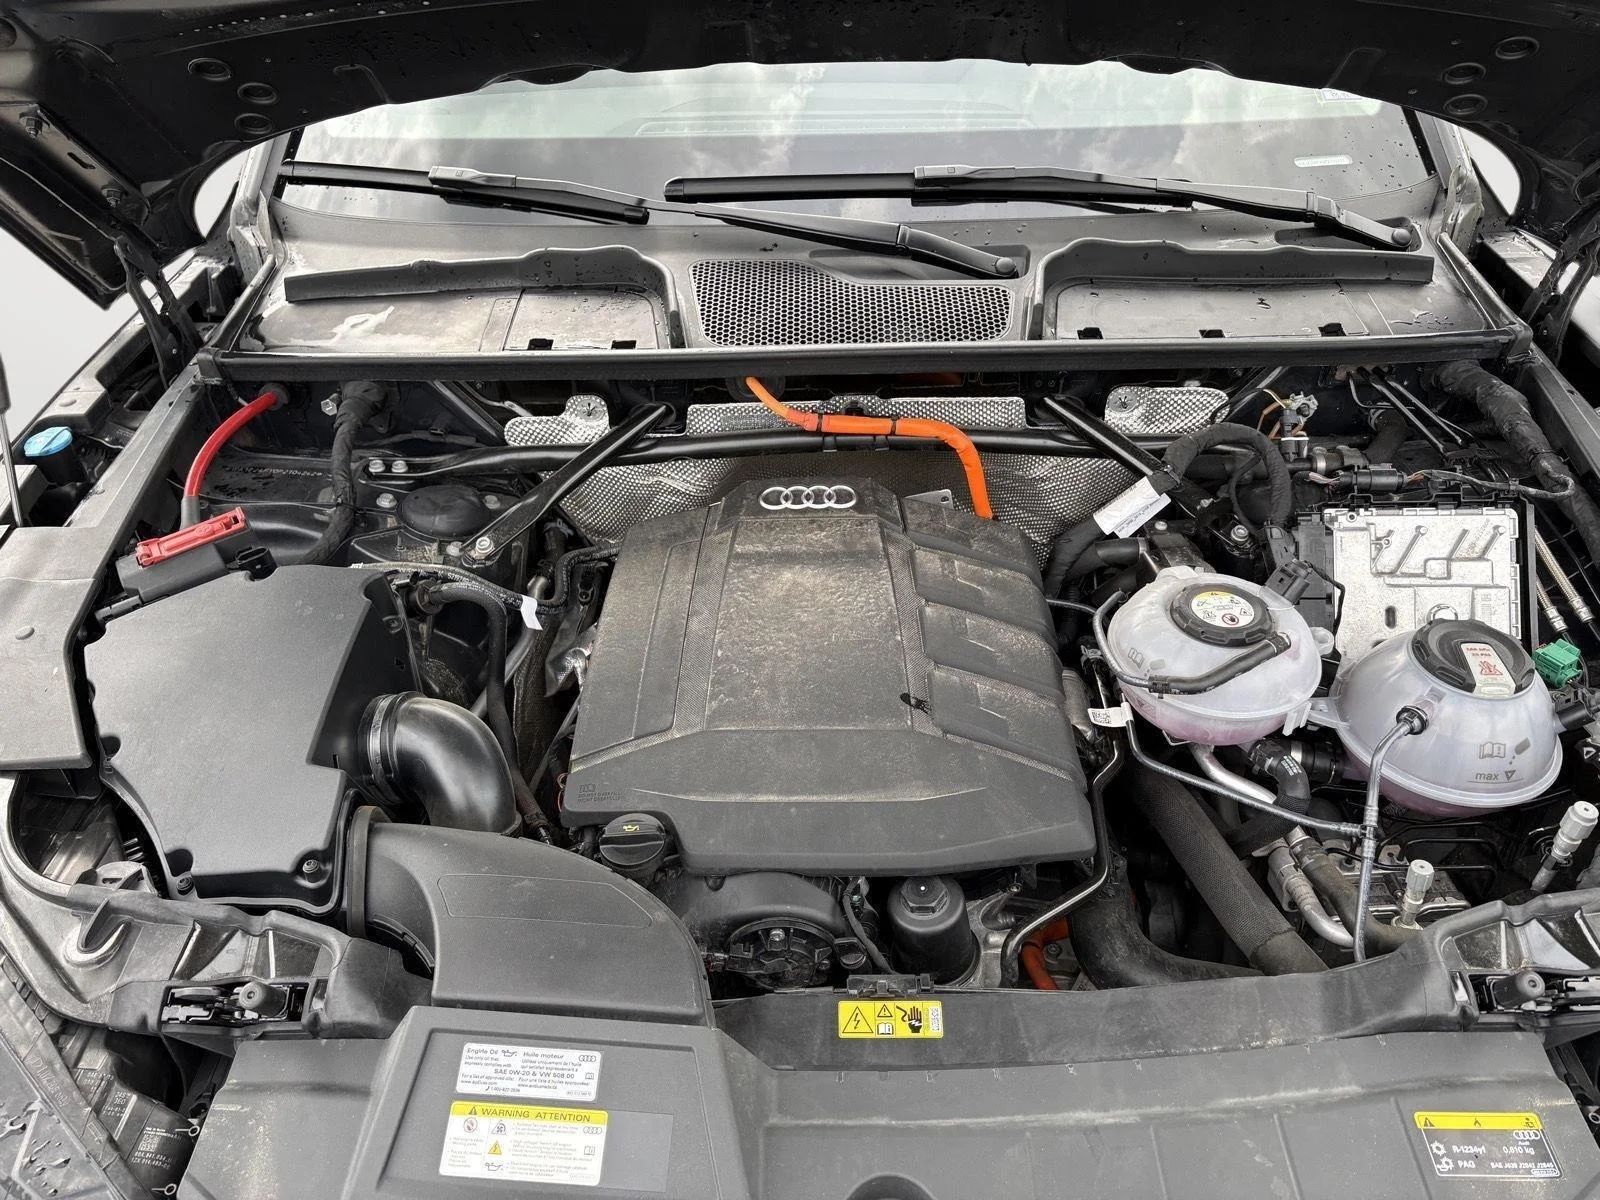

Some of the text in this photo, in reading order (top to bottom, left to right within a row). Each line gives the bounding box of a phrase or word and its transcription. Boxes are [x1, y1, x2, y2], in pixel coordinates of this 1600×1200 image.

[1476, 772, 1499, 781] max
[481, 1108, 591, 1122] WARNING ATTENTION
[1452, 1145, 1486, 1155] R-1234yf
[1525, 1147, 1535, 1155] kg
[1457, 1160, 1476, 1168] PAG
